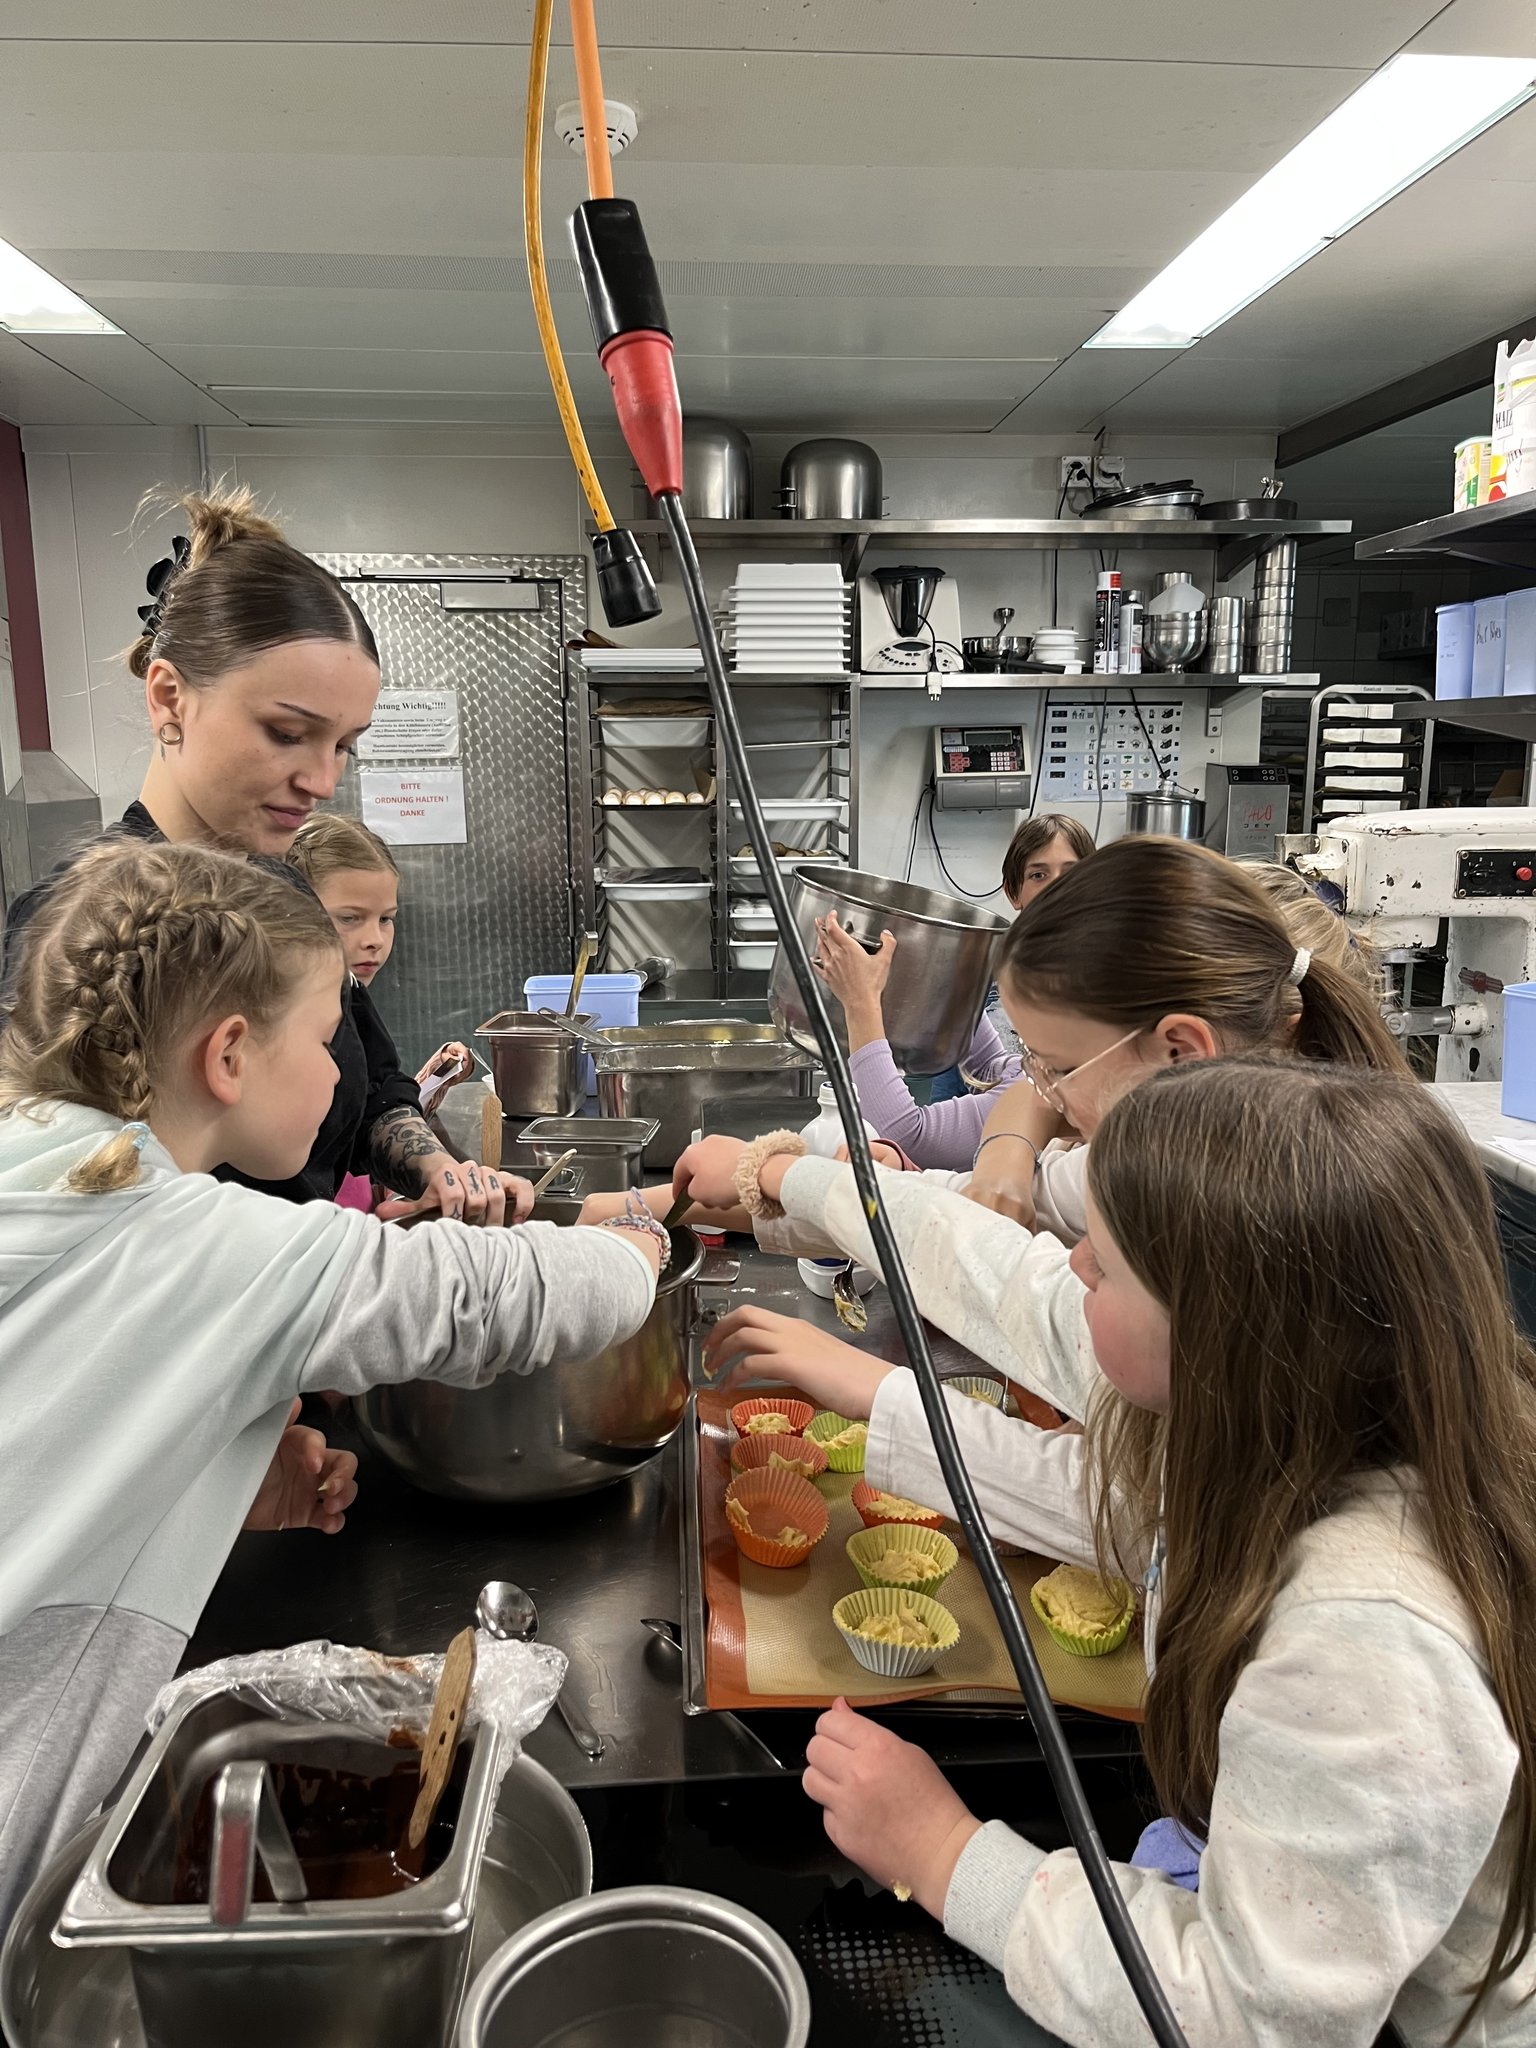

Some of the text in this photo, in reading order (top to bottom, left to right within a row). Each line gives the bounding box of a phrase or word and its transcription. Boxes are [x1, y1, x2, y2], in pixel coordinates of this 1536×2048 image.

[373, 703, 400, 711] chtung
[374, 796, 414, 804] ORDNUNG
[415, 795, 444, 803] HALTEN
